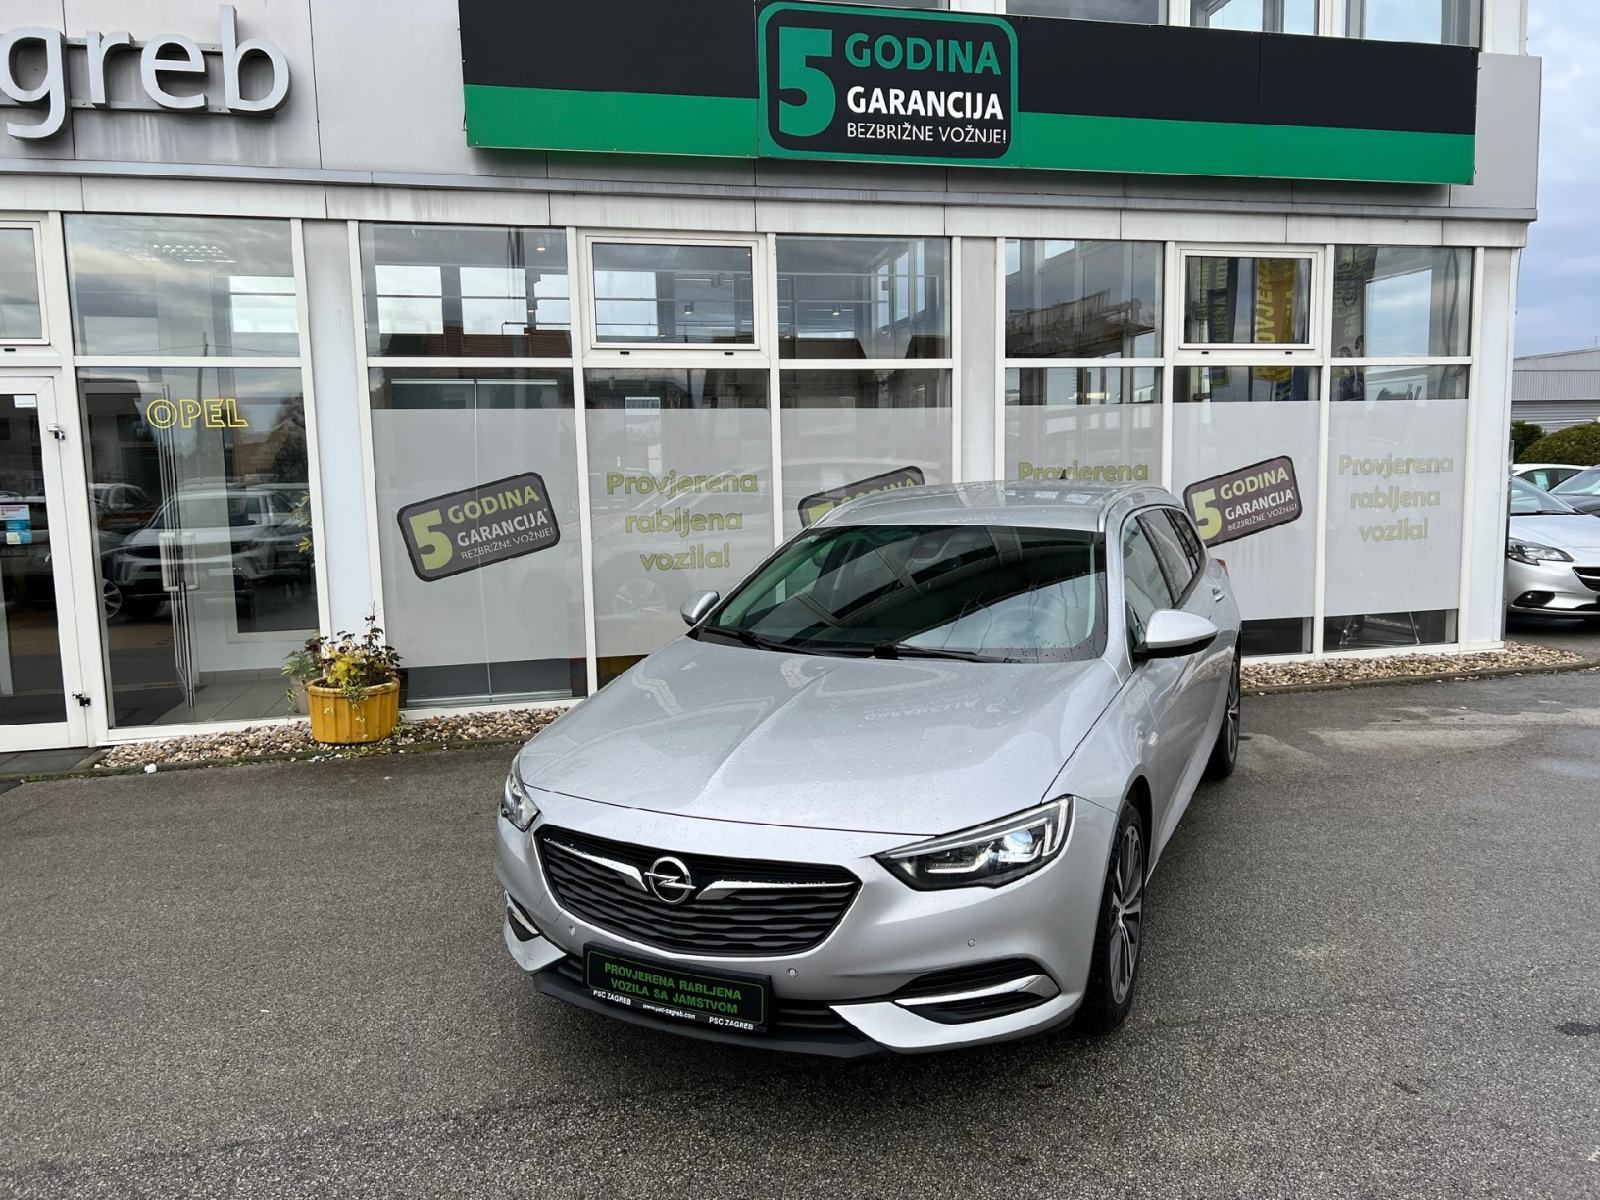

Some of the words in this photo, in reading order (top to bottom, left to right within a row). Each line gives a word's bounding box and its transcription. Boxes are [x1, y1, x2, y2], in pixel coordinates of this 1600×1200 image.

[844, 32, 1002, 76] GODINA
[778, 26, 836, 137] 5
[846, 85, 1004, 121] GARANCIJA
[847, 122, 934, 142] BEZBRIŽNE
[938, 124, 1008, 144] VOŽNJE!
[146, 398, 249, 429] OPEL
[1338, 452, 1455, 480] Provjerena
[606, 469, 759, 501] Provjerena
[1220, 467, 1289, 500] GODINA
[1350, 485, 1441, 513] rabljena
[447, 485, 540, 524] GODINA
[1191, 487, 1223, 541] 5
[624, 506, 743, 538] rabljena
[1358, 516, 1430, 543] vozila!
[408, 508, 453, 570] 5
[639, 542, 731, 572] vozila!
[592, 989, 607, 998] PSC
[607, 992, 632, 1006] ZAGREB
[604, 962, 675, 988] PROVJERENA
[679, 979, 742, 1001] RABLJENA
[611, 977, 650, 997] VOZILA
[653, 988, 669, 1001] SA
[672, 992, 738, 1014] JAMSTVOM
[709, 1016, 724, 1026] PSC
[724, 1019, 754, 1031] ZAGREB
